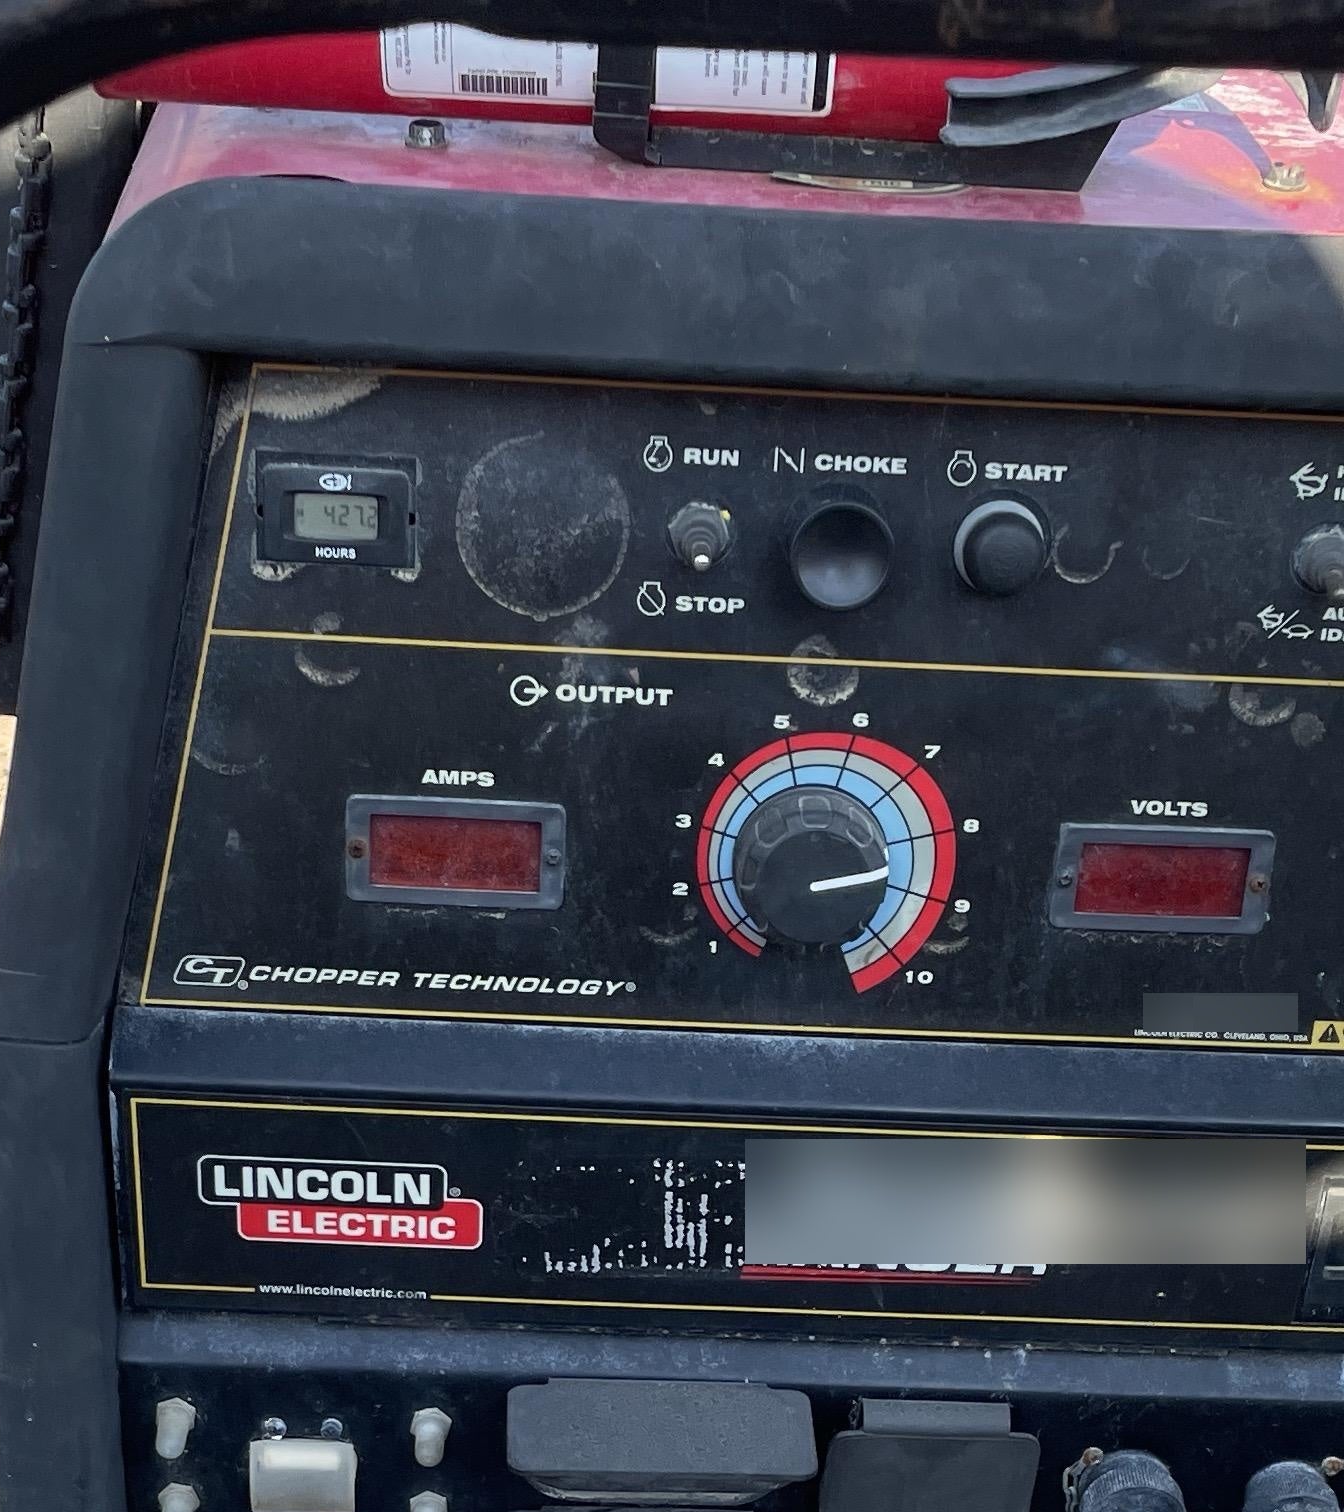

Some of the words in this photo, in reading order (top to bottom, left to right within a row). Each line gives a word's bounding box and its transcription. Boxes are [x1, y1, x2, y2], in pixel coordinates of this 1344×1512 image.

[684, 448, 739, 467] RUN
[814, 455, 908, 474] CHOKE
[985, 463, 1067, 482] START
[315, 546, 356, 560] HOURS
[675, 596, 744, 614] STOP
[556, 685, 672, 706] OUTPUT
[773, 715, 790, 730] 5
[853, 712, 869, 727] 6
[925, 745, 940, 758] 7
[708, 753, 724, 767] 4
[421, 769, 494, 788] AMPS
[1131, 800, 1208, 817] VOLTS
[675, 814, 692, 828] 3
[963, 819, 979, 833] 8
[672, 882, 688, 896] 2
[954, 899, 970, 913] 9
[709, 941, 717, 954] 1
[185, 957, 235, 984] CT
[249, 965, 400, 986] CHOPPER
[905, 971, 933, 984] 10
[214, 1166, 431, 1205] LINCOLN
[267, 1210, 456, 1239] ELECTRIC
[259, 1284, 426, 1299] www.lincolnelectric.com
